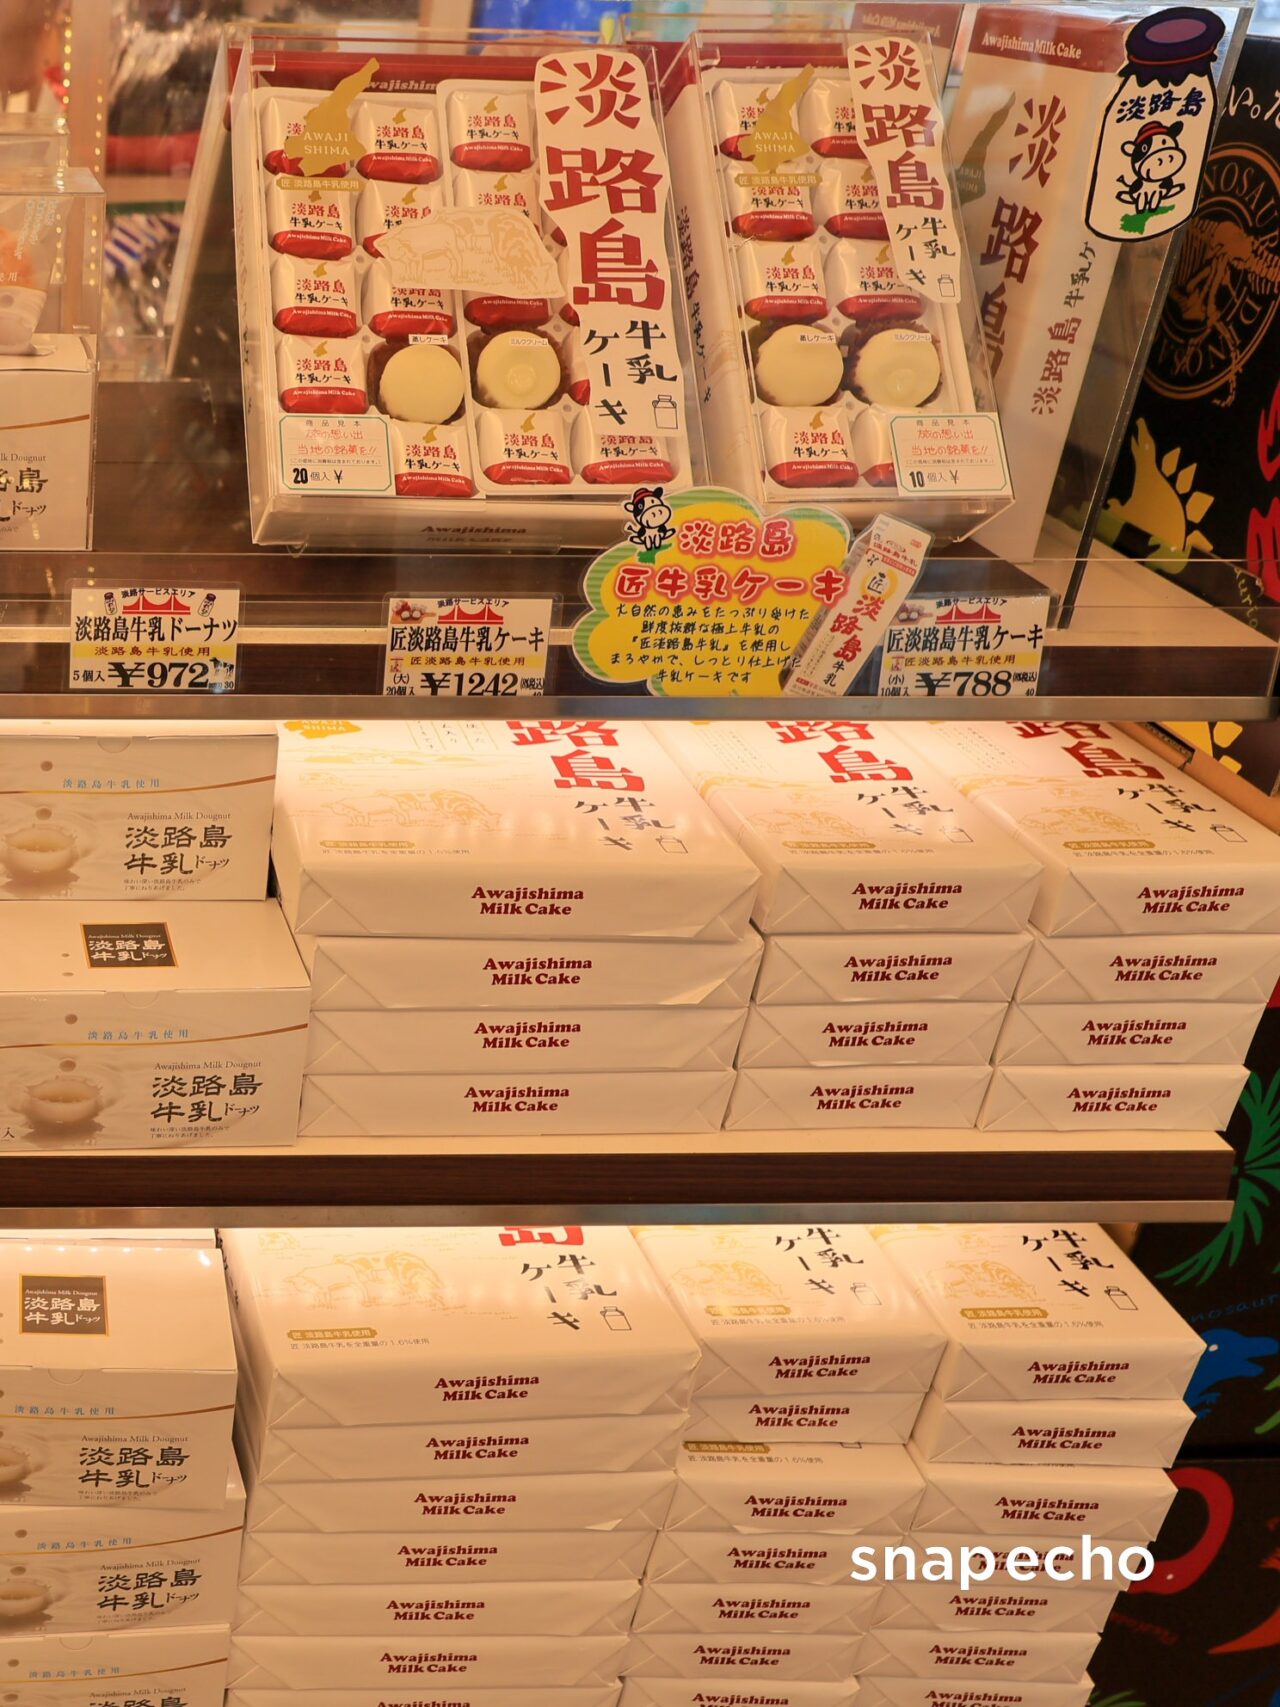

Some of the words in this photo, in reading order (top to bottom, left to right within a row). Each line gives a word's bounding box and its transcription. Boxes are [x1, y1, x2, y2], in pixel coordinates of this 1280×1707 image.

[982, 32, 1034, 53] Awajishima
[1035, 40, 1056, 56] Milk
[1057, 42, 1082, 59] Cake
[1116, 87, 1206, 122] 淡路島
[376, 126, 425, 139] 淡路島
[854, 41, 944, 210] 淡路島
[304, 132, 349, 142] AWAJI
[304, 145, 350, 155] SHIMA
[374, 139, 428, 150] 牛乳ケーキ
[540, 54, 666, 311] 淡路島
[921, 217, 956, 259] 牛乳
[766, 266, 815, 281] 淡路島
[765, 281, 819, 293] 牛乳ケーキ
[625, 319, 678, 385] 牛乳
[296, 358, 348, 372] 淡路島
[294, 372, 352, 384] 牛乳ケーキ
[9, 453, 46, 463] Dougnut
[679, 520, 795, 557] 淡路島
[617, 567, 849, 602] 匠牛乳ケーキ
[75, 616, 238, 642] 淡路島牛乳ドーナツ
[391, 626, 544, 652] 匠淡路島牛乳ケーキ
[887, 624, 1044, 653] 匠淡路島牛乳ケーキ
[95, 646, 210, 656] 淡路島牛乳使用
[411, 657, 525, 666] 匠淡路島牛乳使用
[905, 655, 1016, 666] 匠淡路島牛乳使用
[108, 662, 208, 688] ¥972
[658, 670, 752, 683] 牛乳ケーキです
[421, 672, 518, 696] ¥1242
[916, 670, 1012, 696] ¥788
[63, 779, 160, 789] 淡路島牛乳使用
[128, 813, 172, 822] Awajishima
[196, 812, 231, 821] Dougnut
[125, 825, 232, 849] 淡路島
[124, 852, 230, 875] 牛乳ドーナツ
[472, 887, 584, 903] Awajishima
[852, 882, 962, 898] Awajishima
[480, 903, 522, 914] Milk
[525, 903, 571, 915] Cake
[859, 898, 900, 909] Milk
[903, 898, 948, 909] Cake
[89, 940, 165, 951] 淡路島
[90, 952, 167, 961] 牛乳ドーナツ
[483, 958, 592, 973] Awajishima
[492, 974, 532, 985] Milk
[535, 973, 580, 984] Cake
[152, 1073, 263, 1098] 淡路島
[1067, 1088, 1171, 1102] Awajishima
[151, 1100, 260, 1123] 牛乳ドーナツ
[1073, 1102, 1111, 1112] Milk
[1115, 1101, 1157, 1111] Cake
[434, 1375, 539, 1390] Awajishima
[443, 1390, 482, 1401] Milk
[485, 1389, 528, 1399] Cake
[81, 1435, 128, 1444] Awajishima
[152, 1436, 188, 1444] Dougnut
[1012, 1426, 1116, 1440] Awajishima
[1018, 1439, 1057, 1448] Milk
[1060, 1440, 1102, 1449] Cake
[79, 1447, 190, 1466] 淡路島
[78, 1469, 187, 1488] 牛乳ドーナツ
